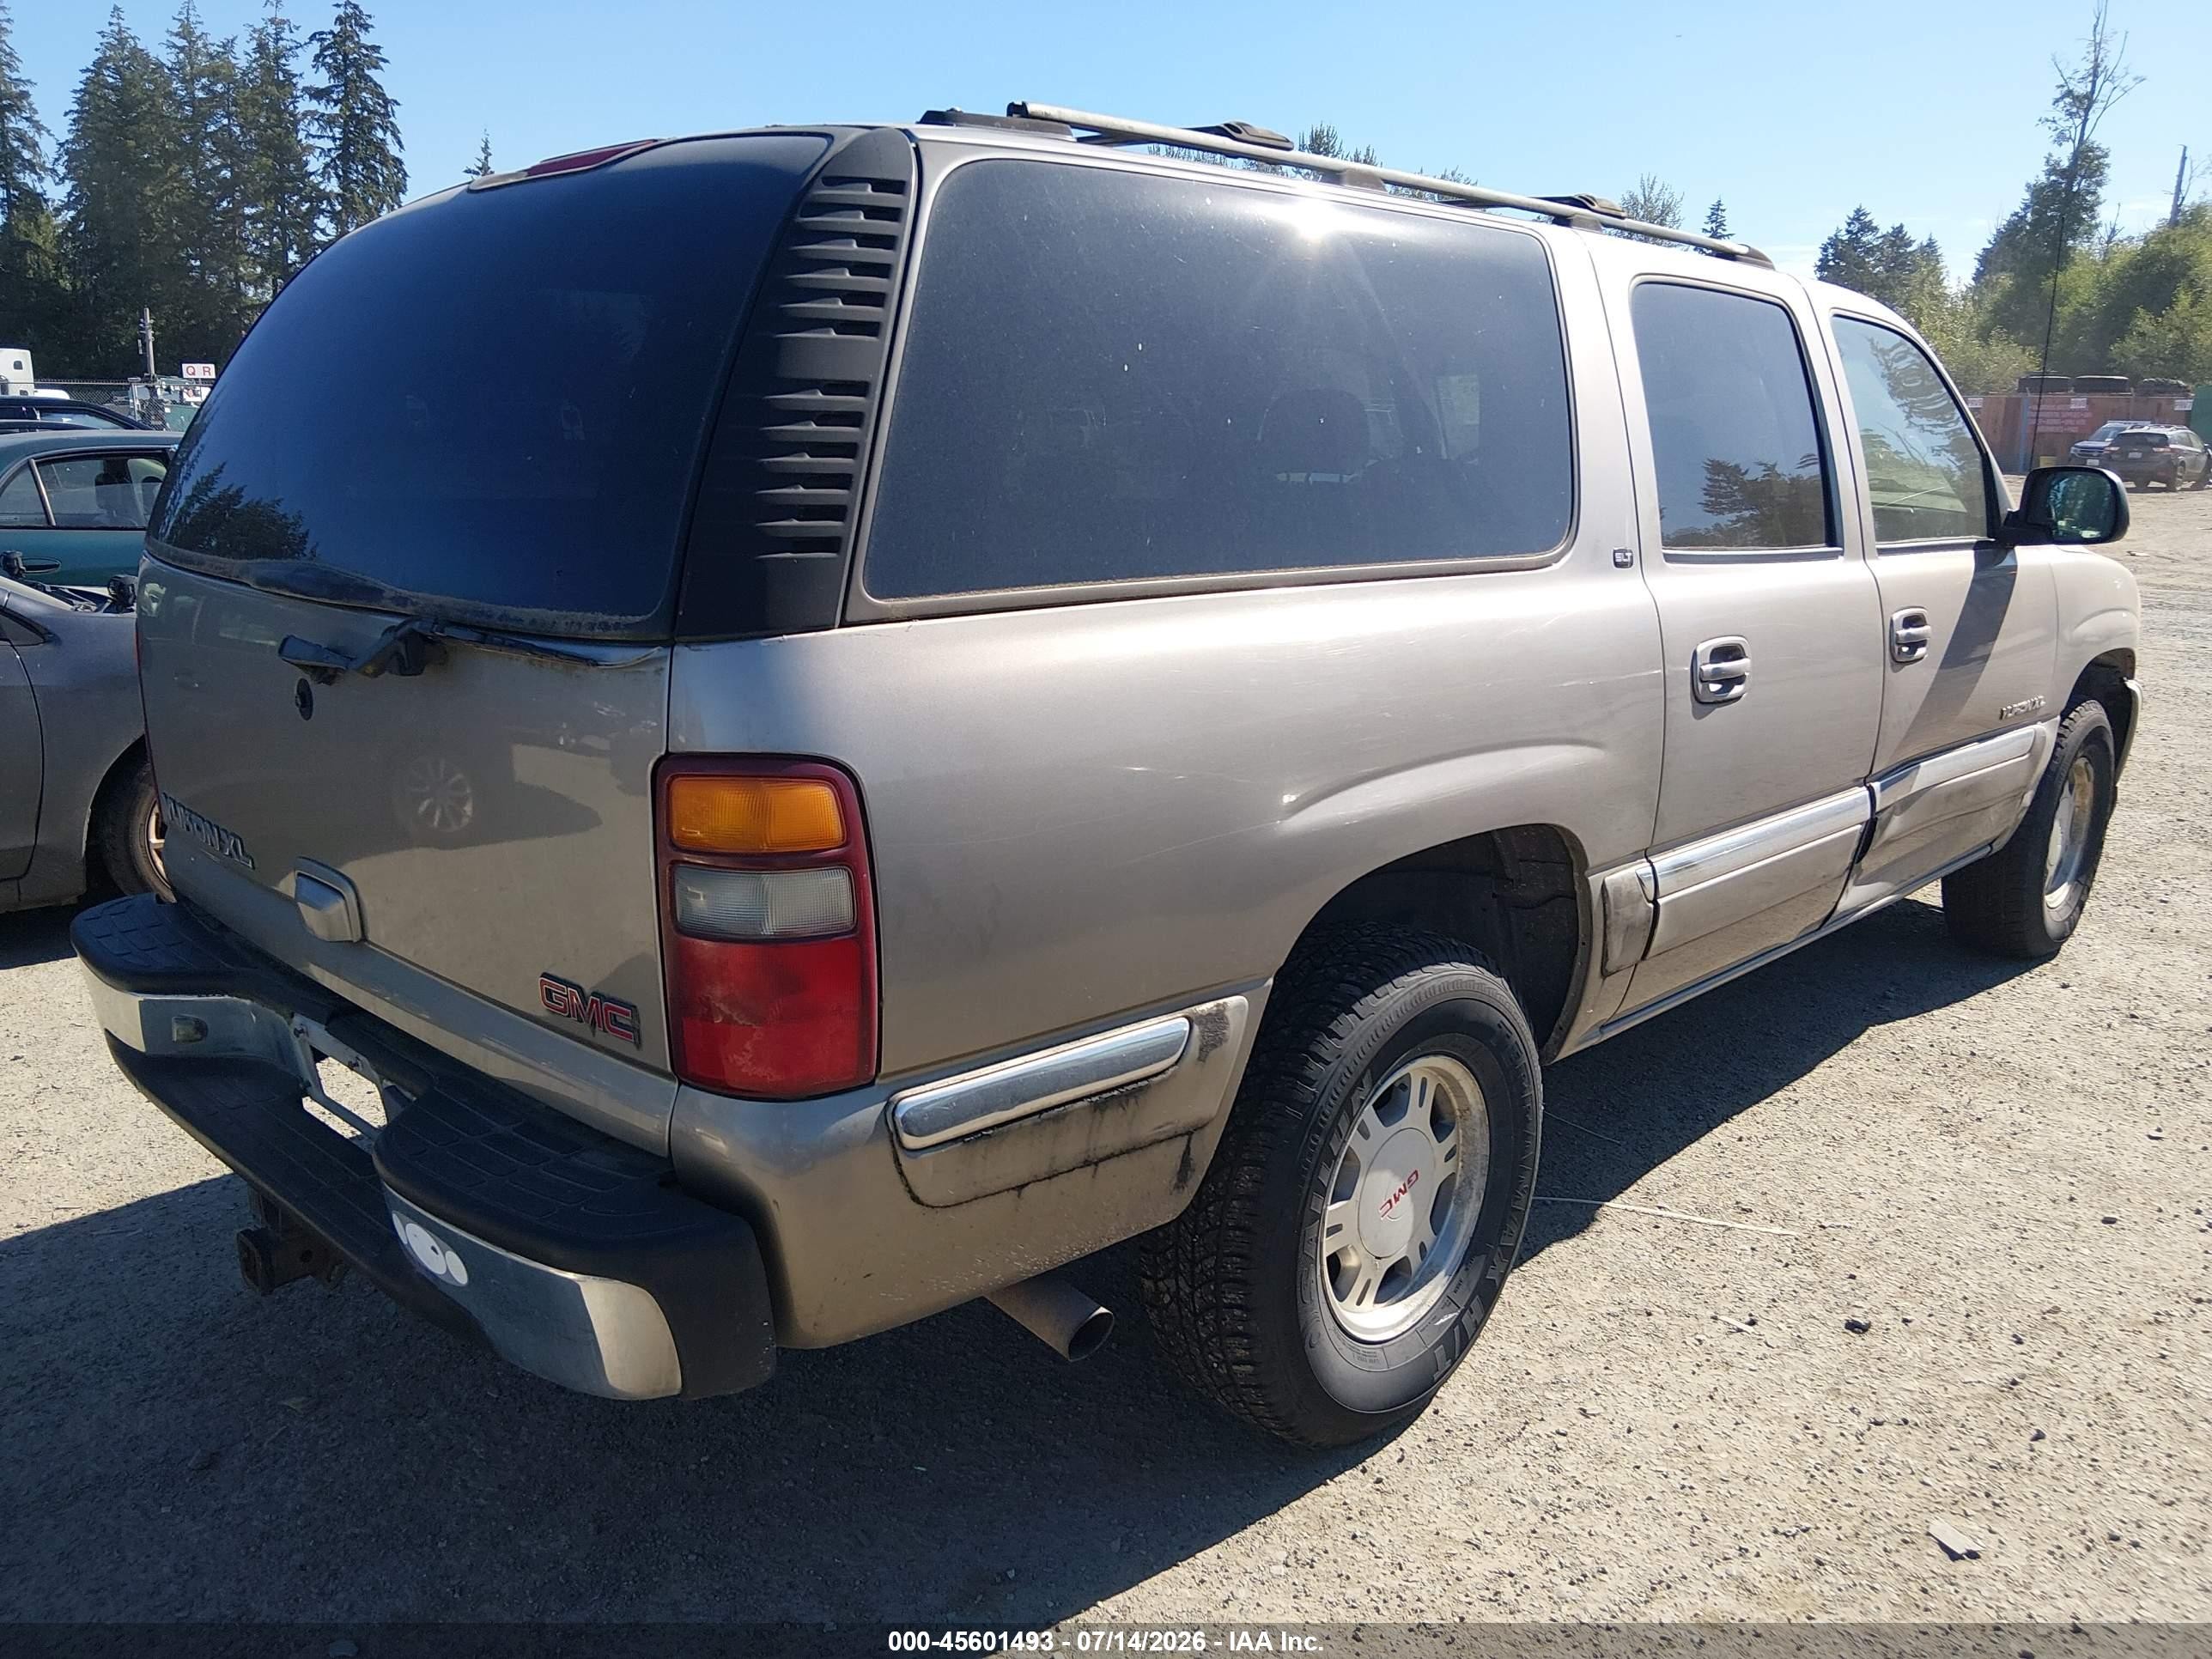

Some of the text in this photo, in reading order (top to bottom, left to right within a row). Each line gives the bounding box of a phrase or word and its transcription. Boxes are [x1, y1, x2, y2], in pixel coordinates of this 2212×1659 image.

[185, 365, 211, 376] Q R
[538, 973, 639, 1045] GMC
[1378, 1169, 1419, 1218] GMC
